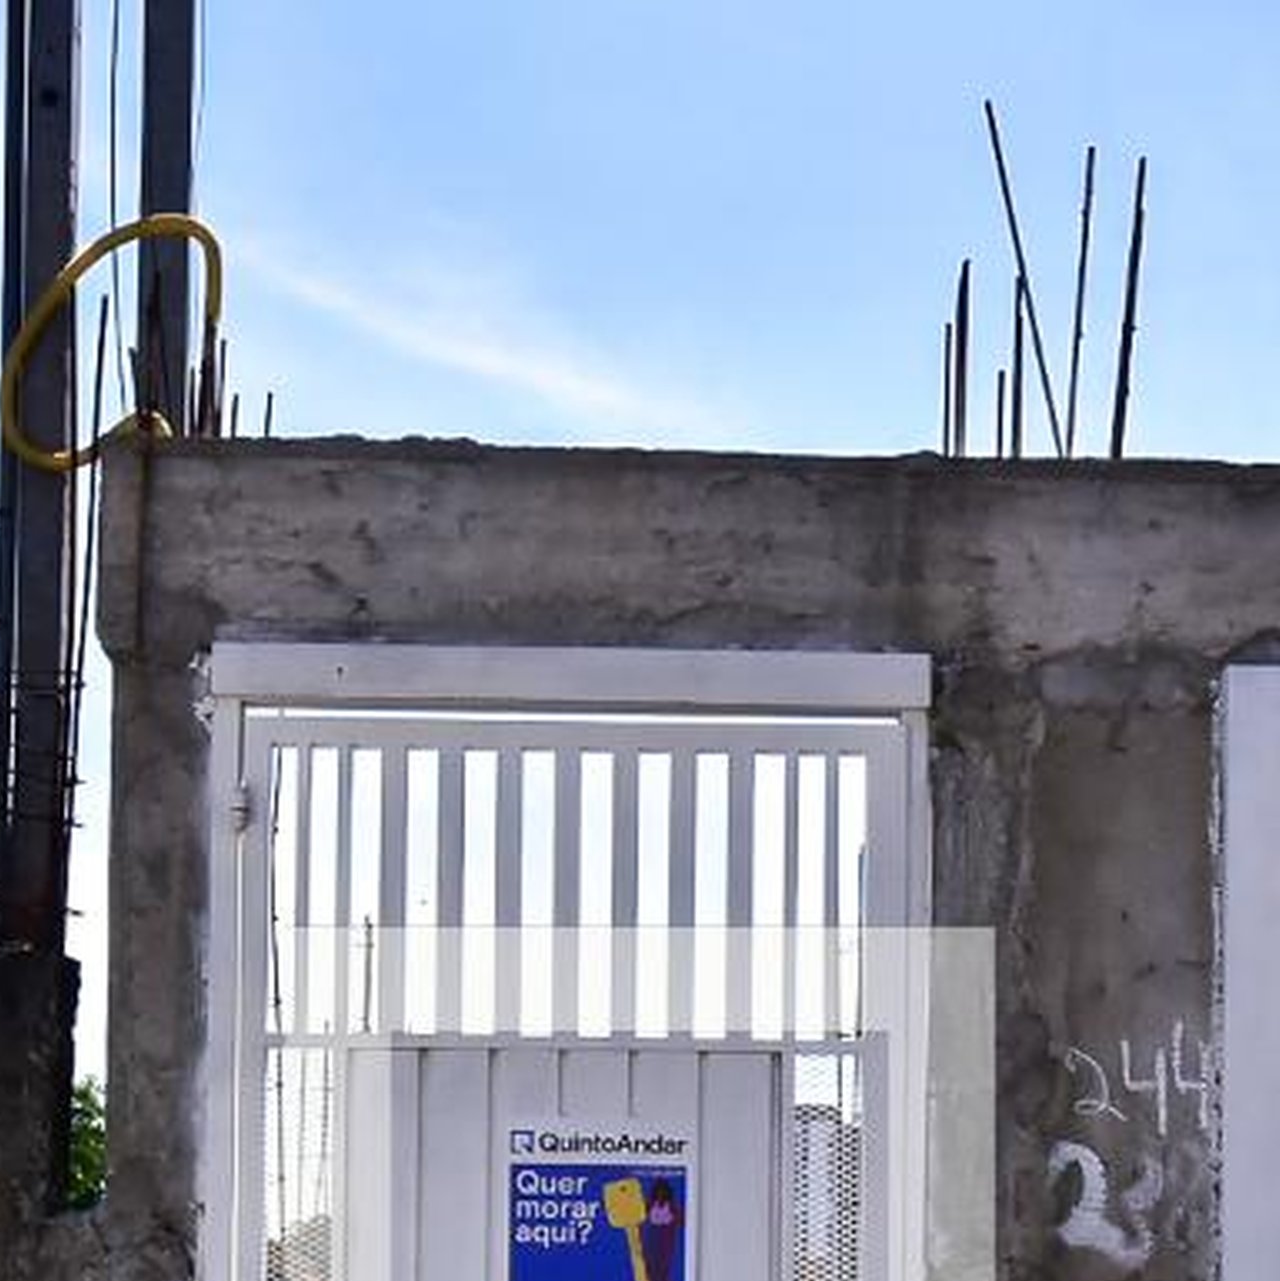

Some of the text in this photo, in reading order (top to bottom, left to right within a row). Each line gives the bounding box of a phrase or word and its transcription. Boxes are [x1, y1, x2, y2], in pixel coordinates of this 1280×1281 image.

[538, 1132, 688, 1154] QuintoAndar
[516, 1170, 588, 1195] Quer
[516, 1201, 600, 1219] morar
[515, 1220, 593, 1248] aqui?
